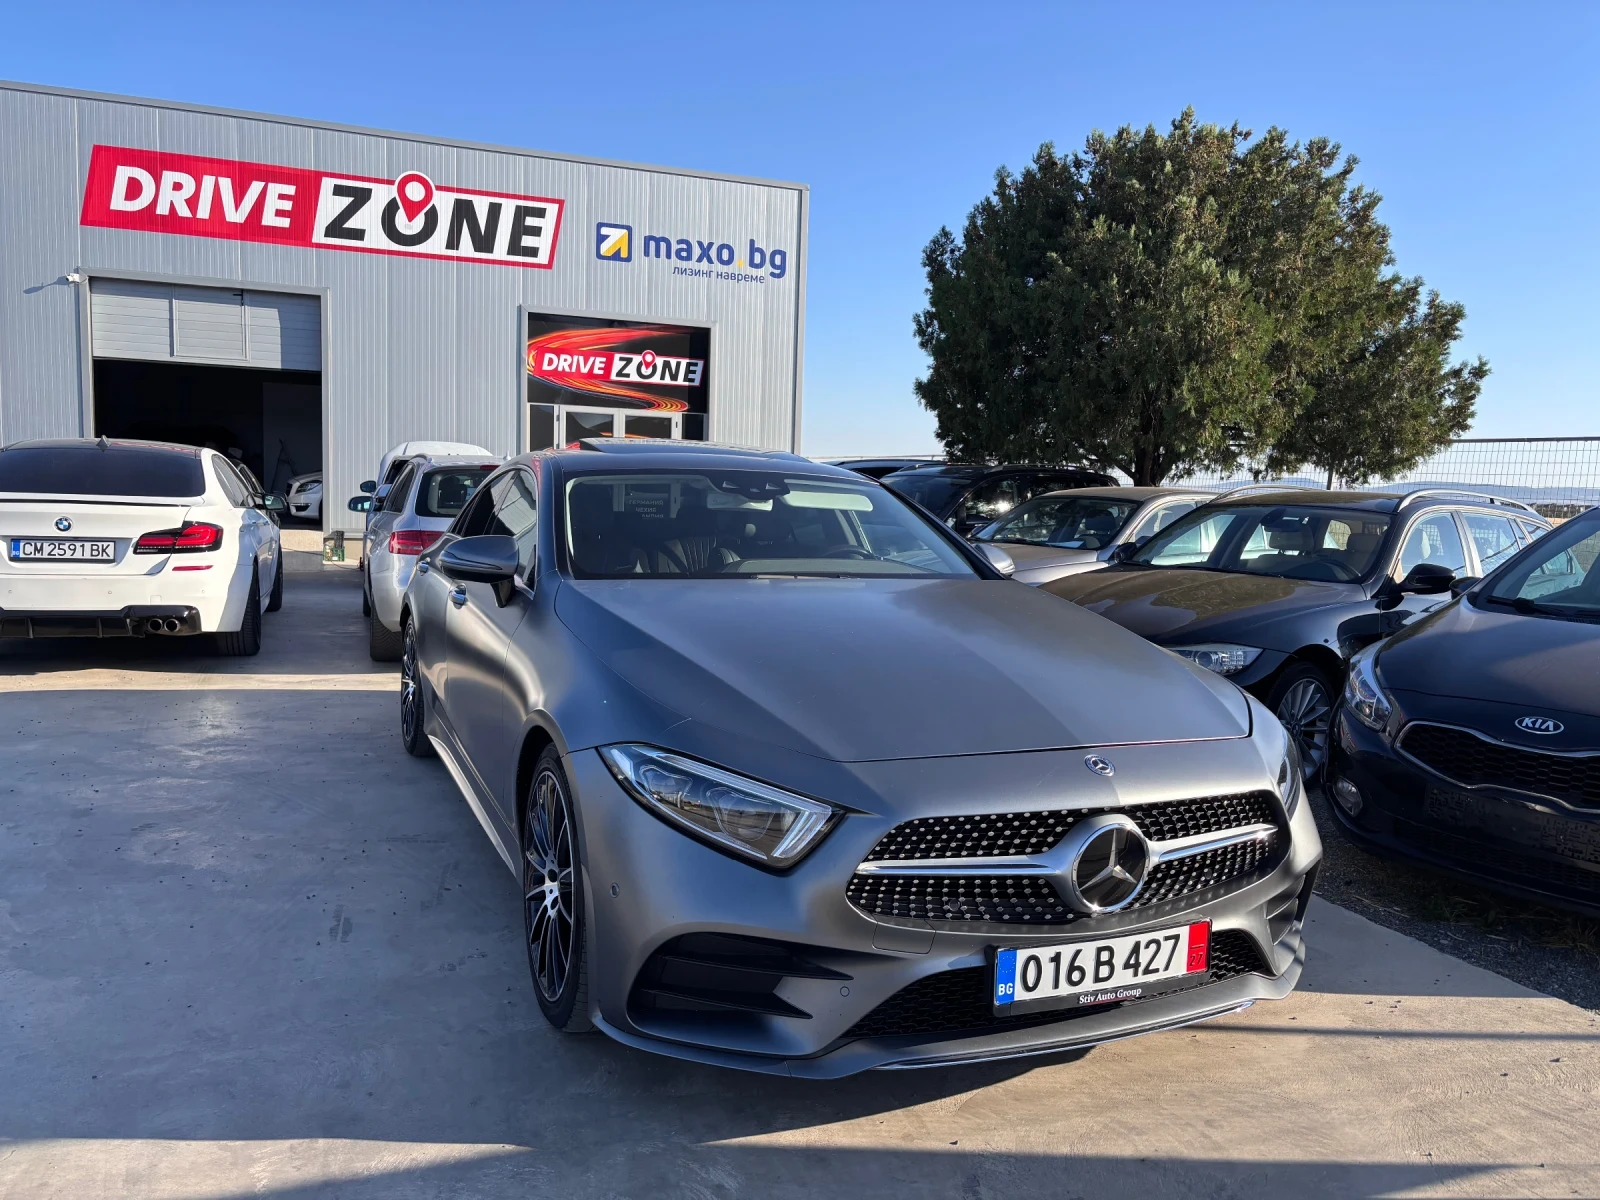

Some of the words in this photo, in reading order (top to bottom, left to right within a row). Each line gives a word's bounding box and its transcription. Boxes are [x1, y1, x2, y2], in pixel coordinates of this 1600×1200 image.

[109, 164, 297, 228] DRIVE
[324, 176, 548, 258] ZONE
[643, 234, 787, 279] maxo.bg
[672, 266, 714, 279] лизинг
[716, 269, 766, 284] навреме
[541, 352, 607, 375] DRIVE
[615, 354, 699, 384] ZONE
[22, 542, 44, 556] CM
[47, 542, 86, 557] 2591
[90, 543, 111, 558] BK
[1521, 717, 1555, 732] KIA
[1020, 948, 1087, 993] 016
[1092, 944, 1116, 984] B
[1123, 933, 1181, 978] 427
[998, 982, 1014, 996] BG
[1079, 994, 1096, 1004] Stiv
[1096, 992, 1116, 1002] Auto
[1117, 988, 1142, 998] Group
